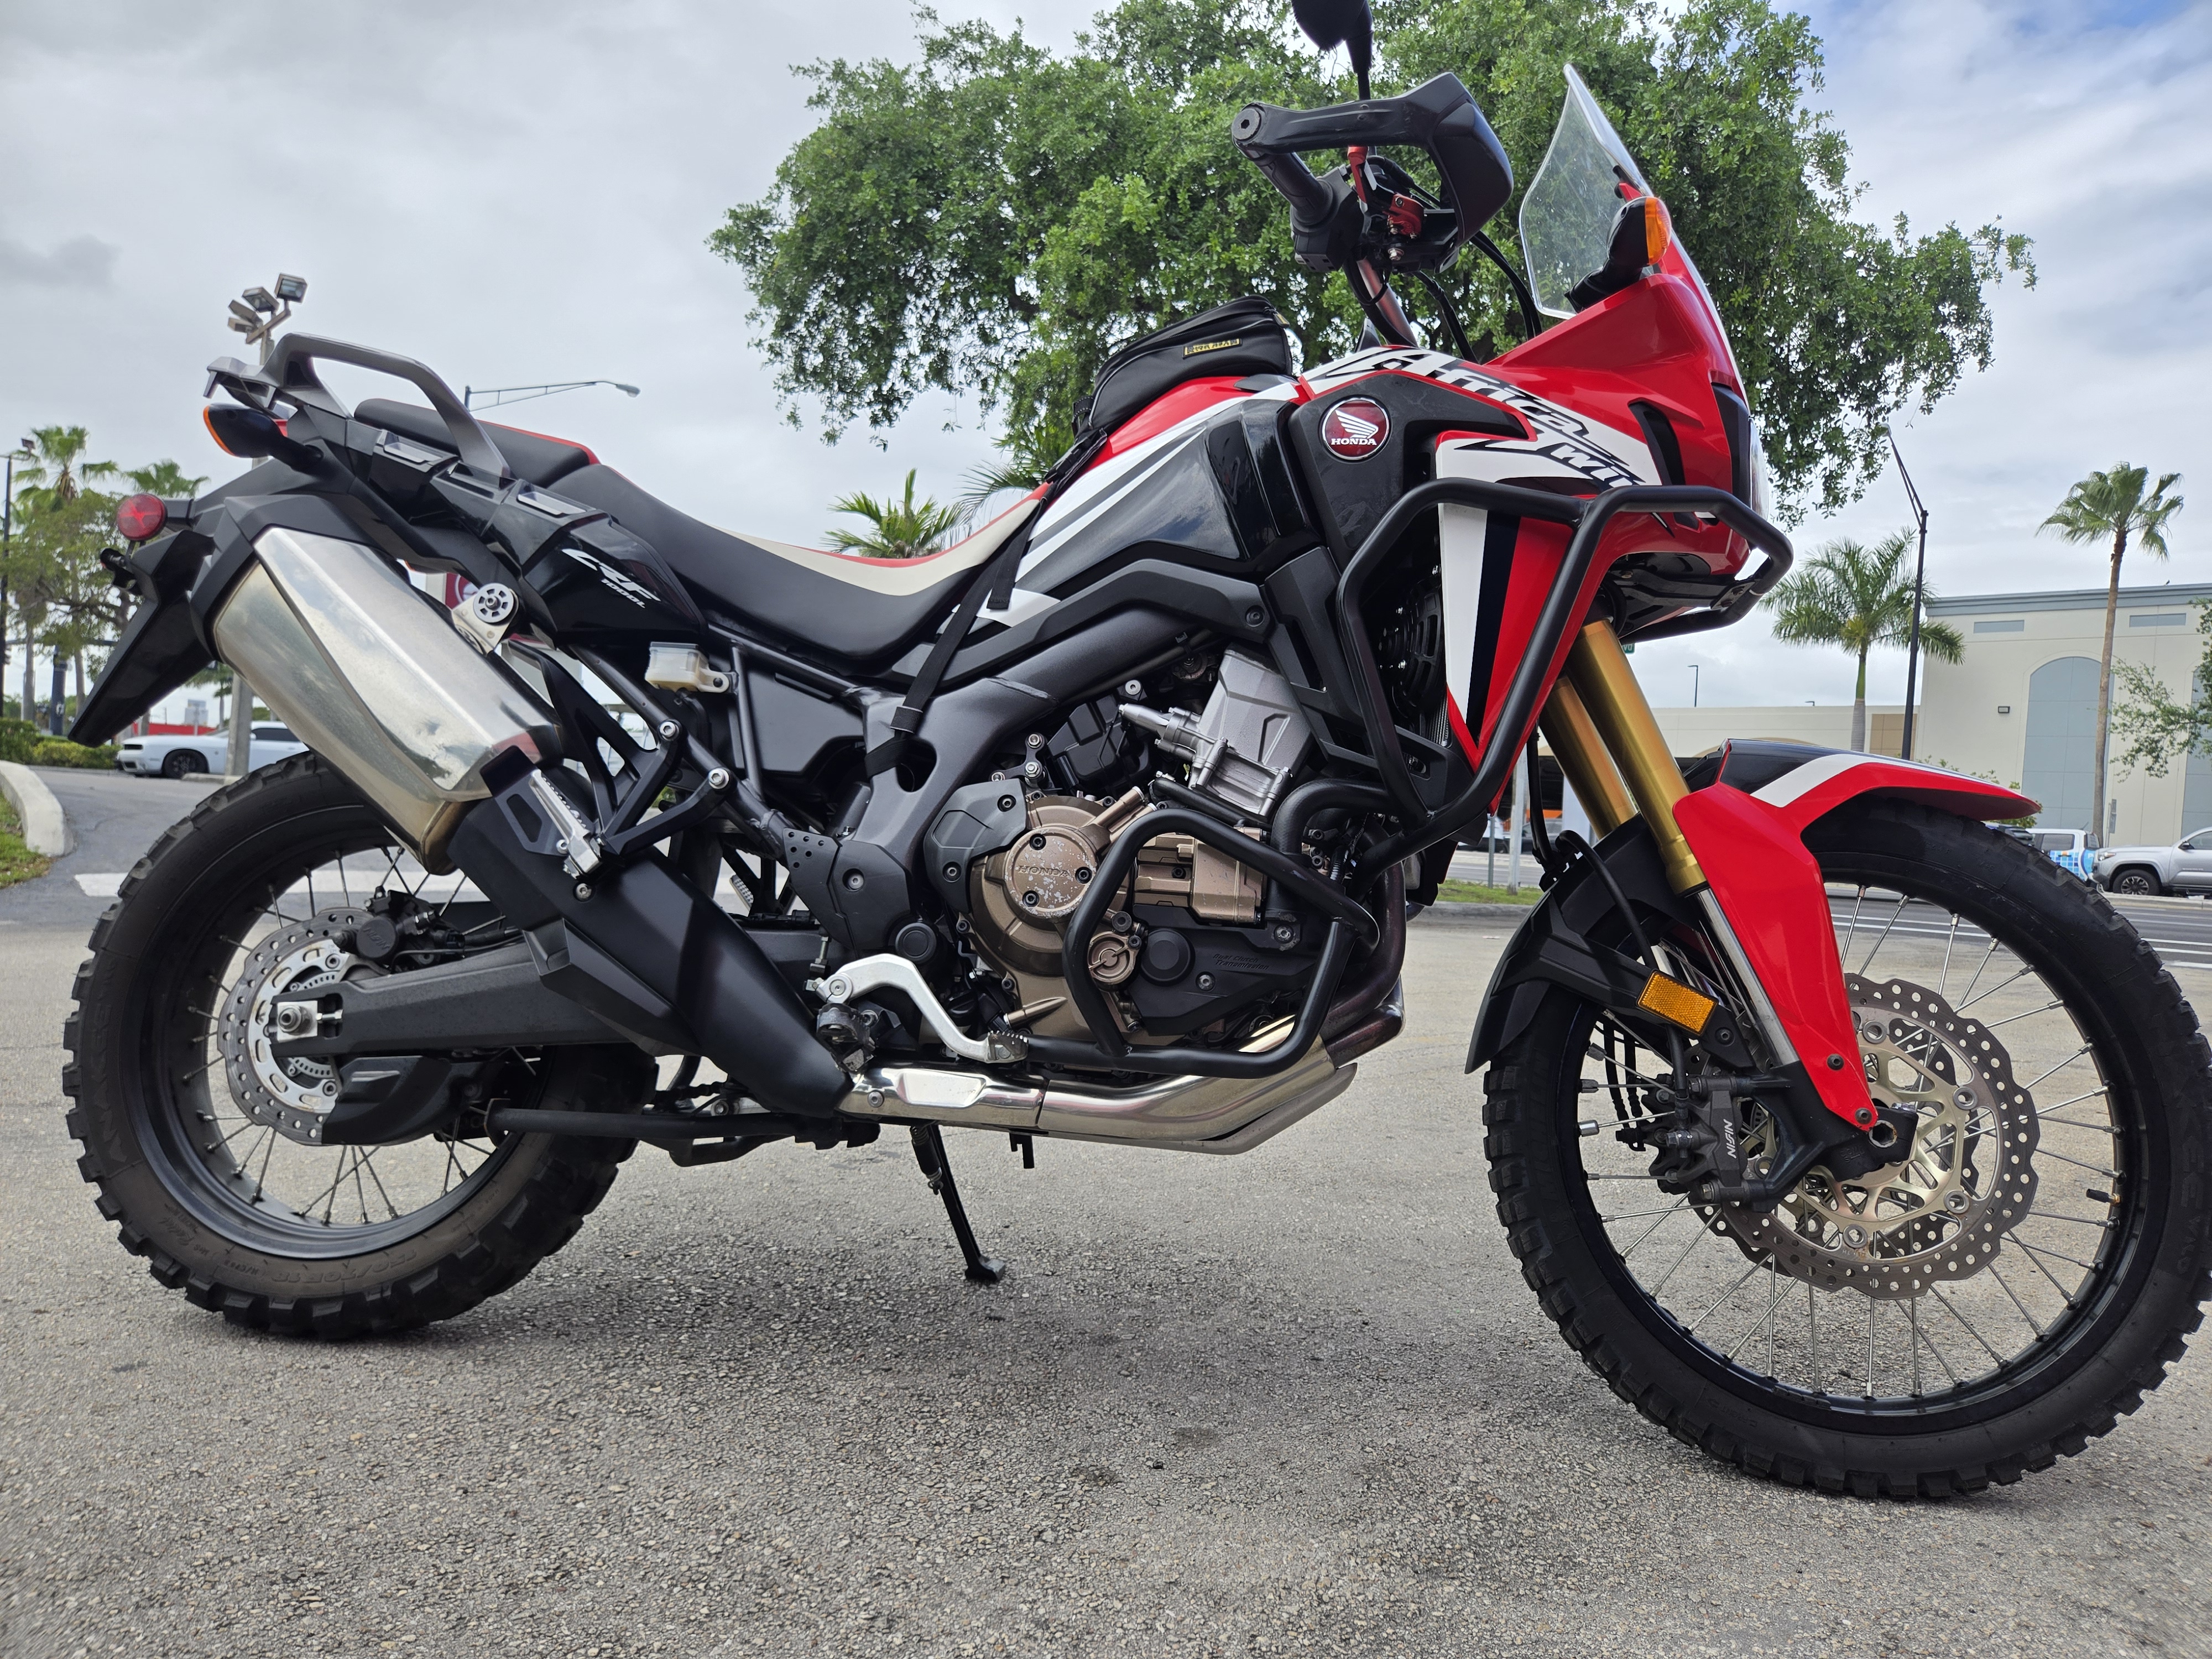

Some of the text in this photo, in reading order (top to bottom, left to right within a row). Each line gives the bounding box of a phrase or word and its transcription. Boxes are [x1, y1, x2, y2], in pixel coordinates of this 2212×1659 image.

[1377, 346, 1590, 437] Africa
[1331, 437, 1378, 446] HONDA
[561, 547, 661, 602] CRF
[601, 578, 646, 609] 1000L
[1018, 865, 1071, 878] HONDA
[1215, 959, 1270, 971] Transmission
[1233, 955, 1259, 963] Clutch
[1723, 1119, 1736, 1159] NISSIN
